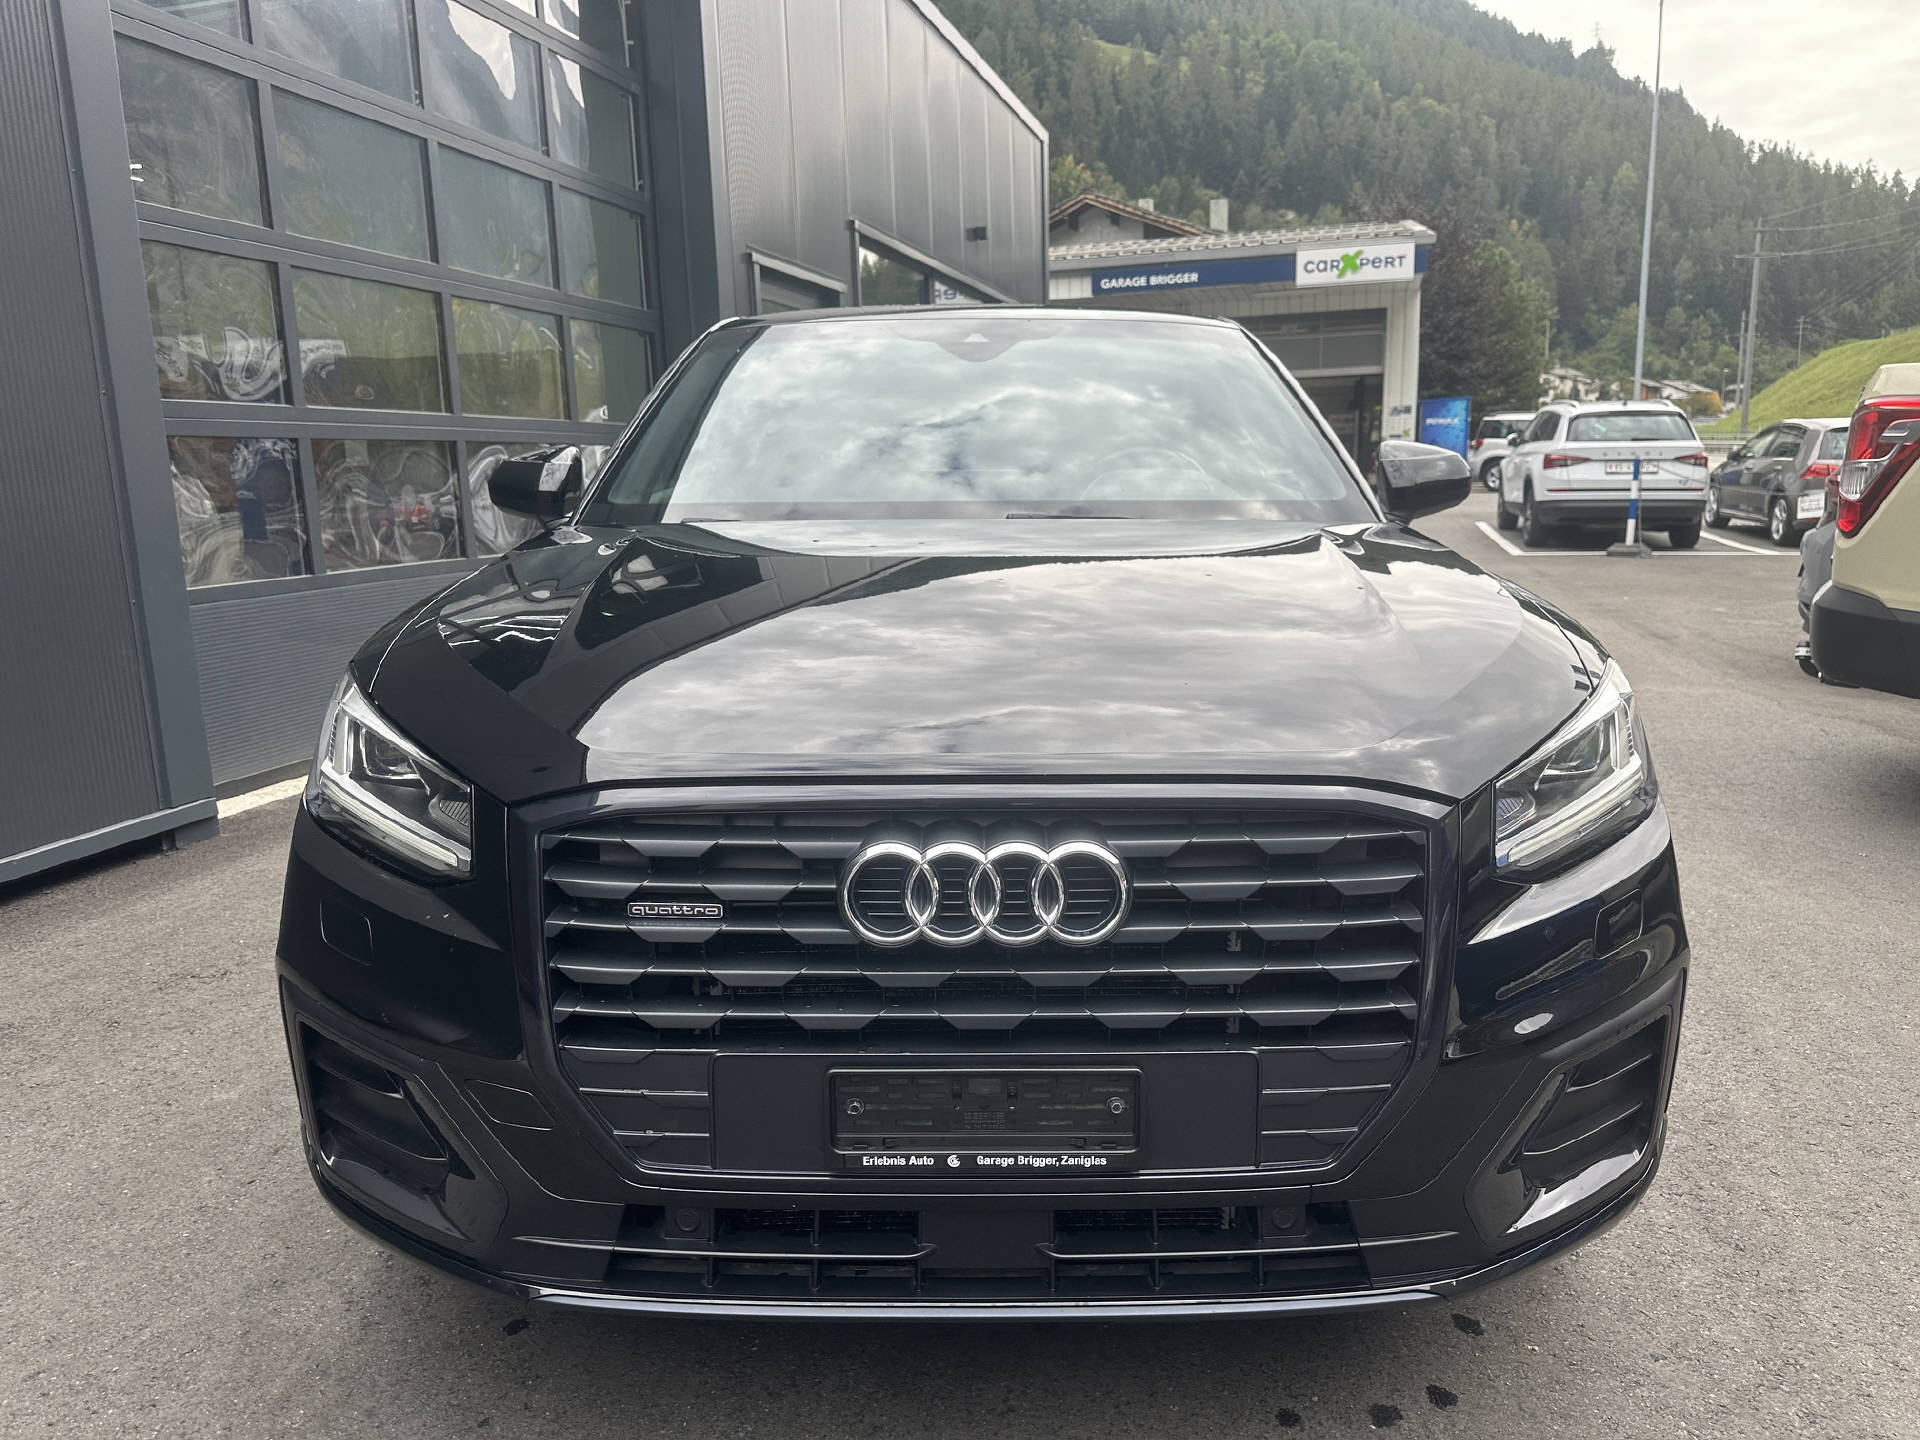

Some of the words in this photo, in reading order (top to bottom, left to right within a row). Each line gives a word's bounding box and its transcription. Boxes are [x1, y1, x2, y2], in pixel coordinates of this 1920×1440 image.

[1100, 275, 1148, 289] GARAGE
[1149, 271, 1199, 286] BRIGGER
[631, 905, 719, 916] quattro
[862, 1155, 906, 1166] Erlebnis
[908, 1155, 935, 1166] Auto
[976, 1155, 1015, 1168] Garage
[1017, 1155, 1060, 1168] Brigger,
[1061, 1155, 1107, 1168] Zaniglas
